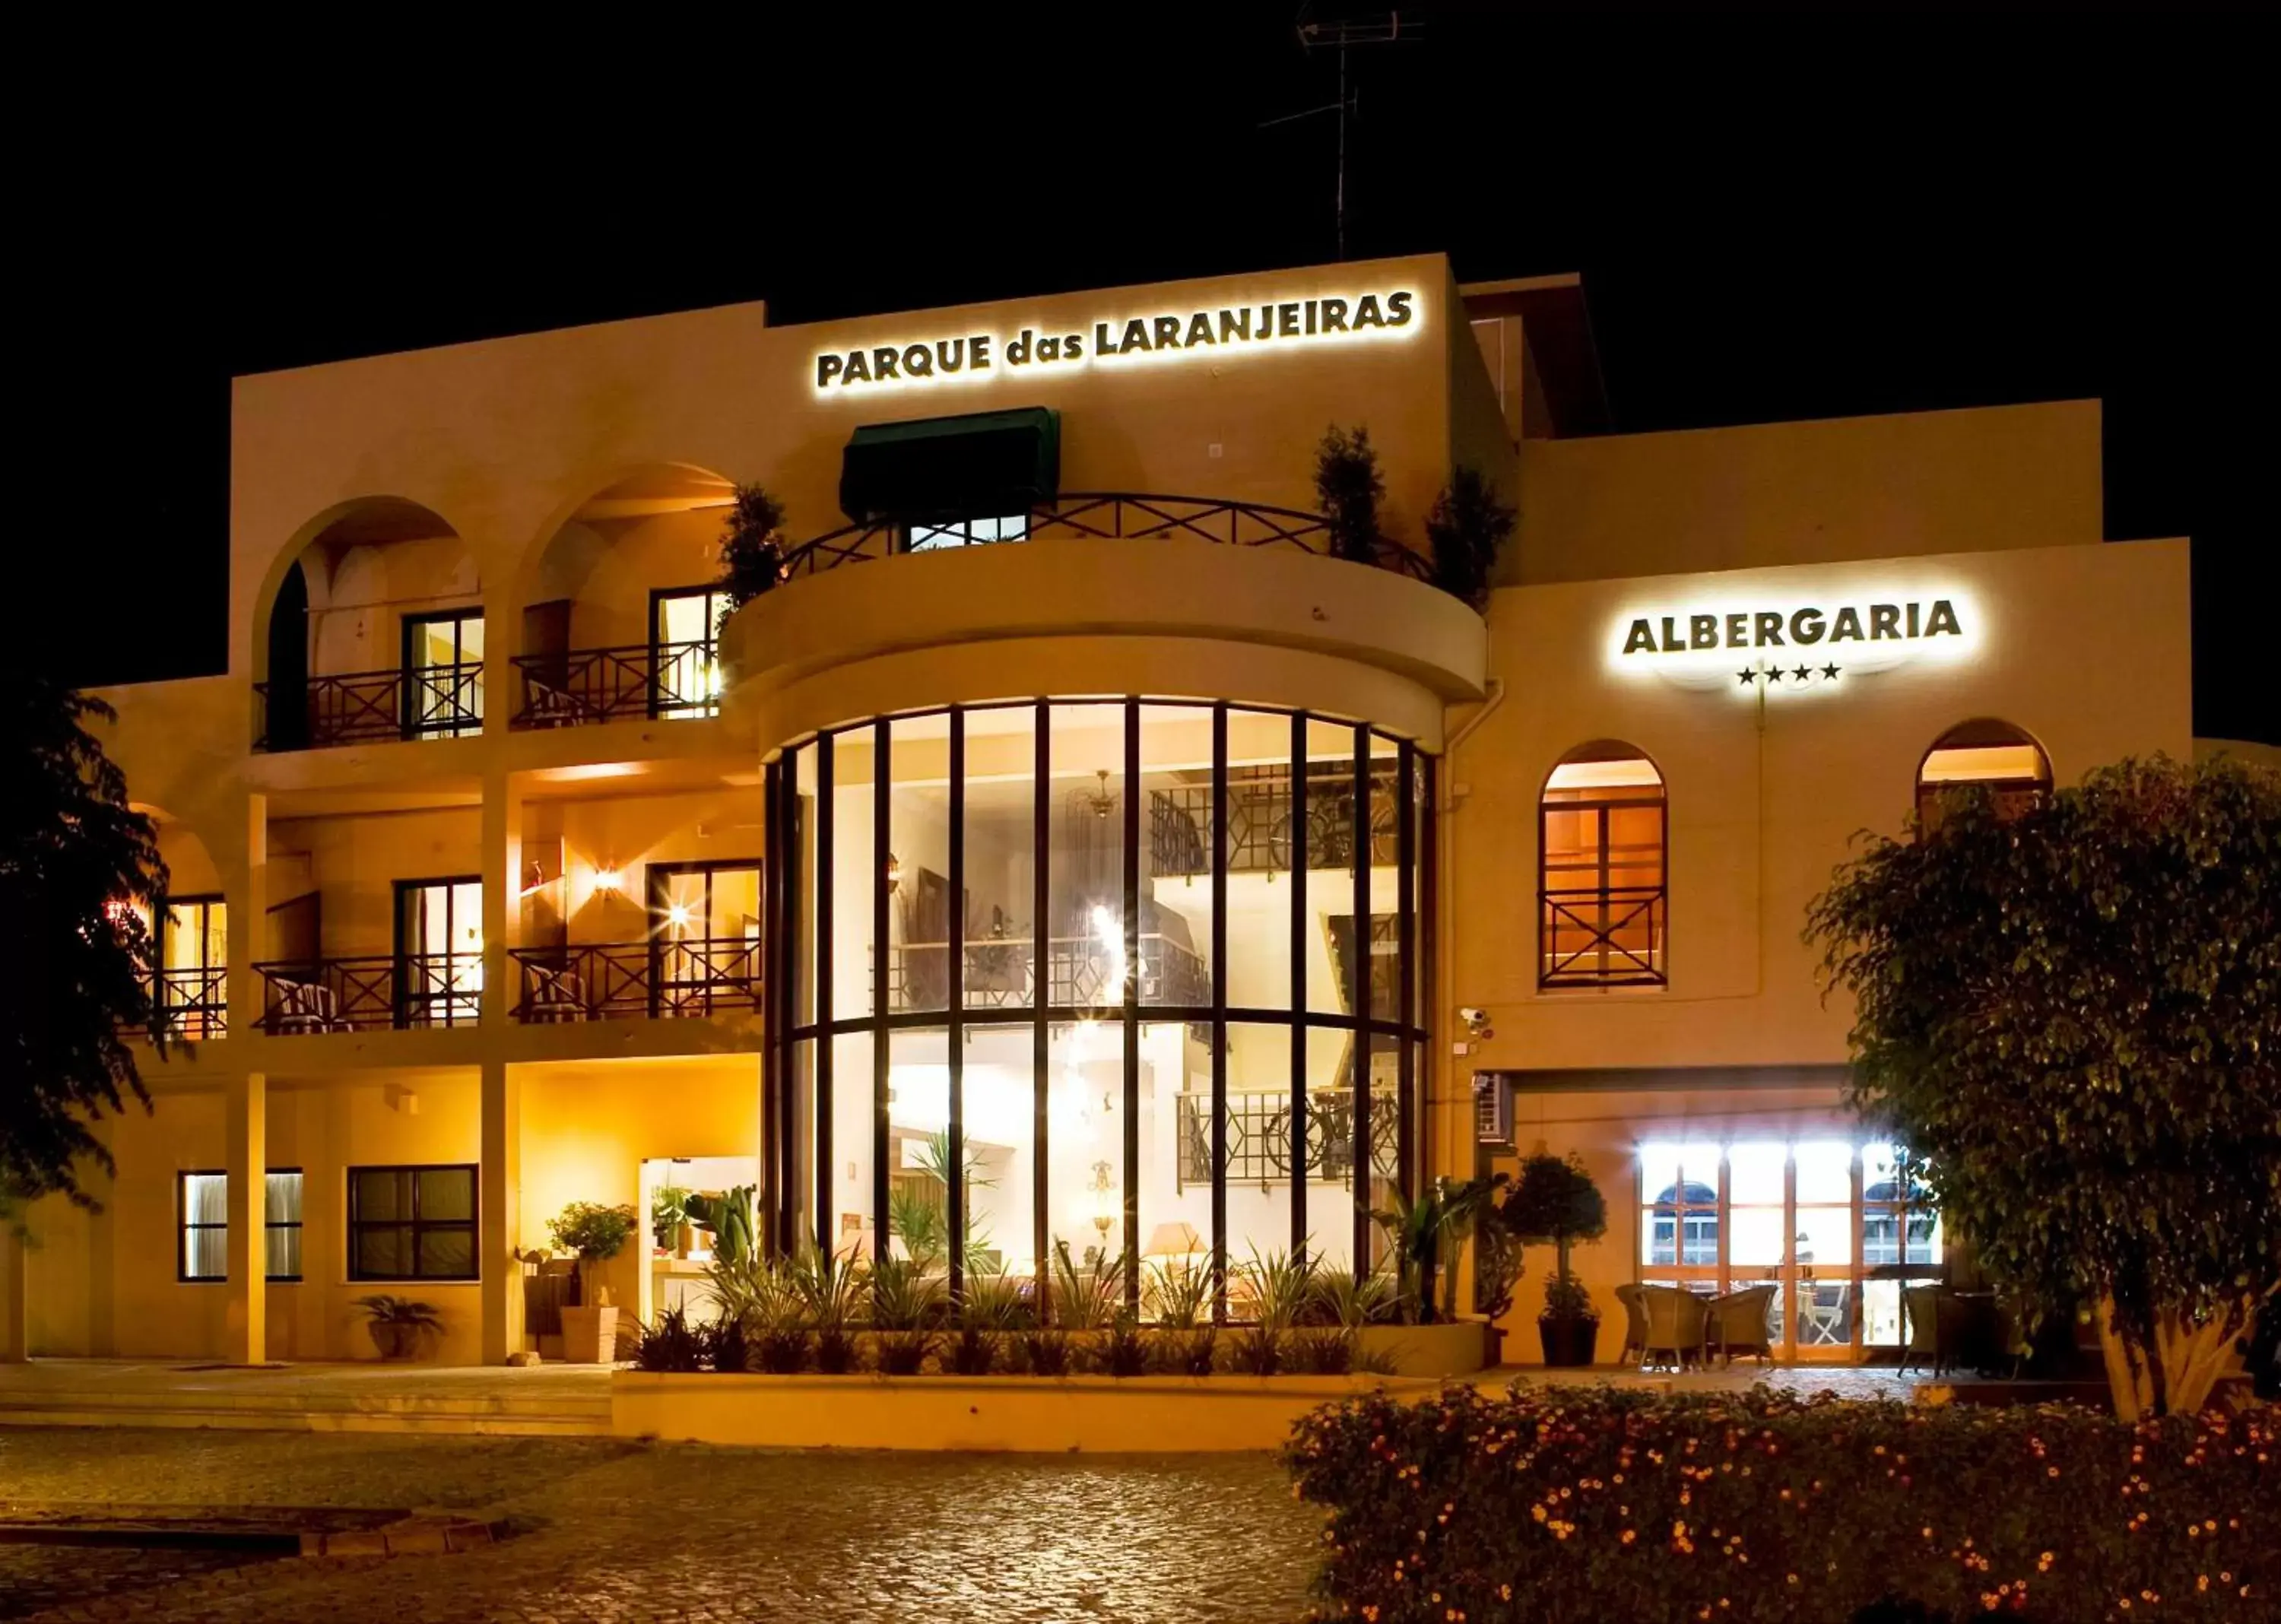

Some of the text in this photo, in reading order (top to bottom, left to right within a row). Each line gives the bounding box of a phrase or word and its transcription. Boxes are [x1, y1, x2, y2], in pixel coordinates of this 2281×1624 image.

[817, 291, 1413, 387] PARQUE das LARANJEIRAS
[1623, 600, 1962, 653] ALBERGARIA
